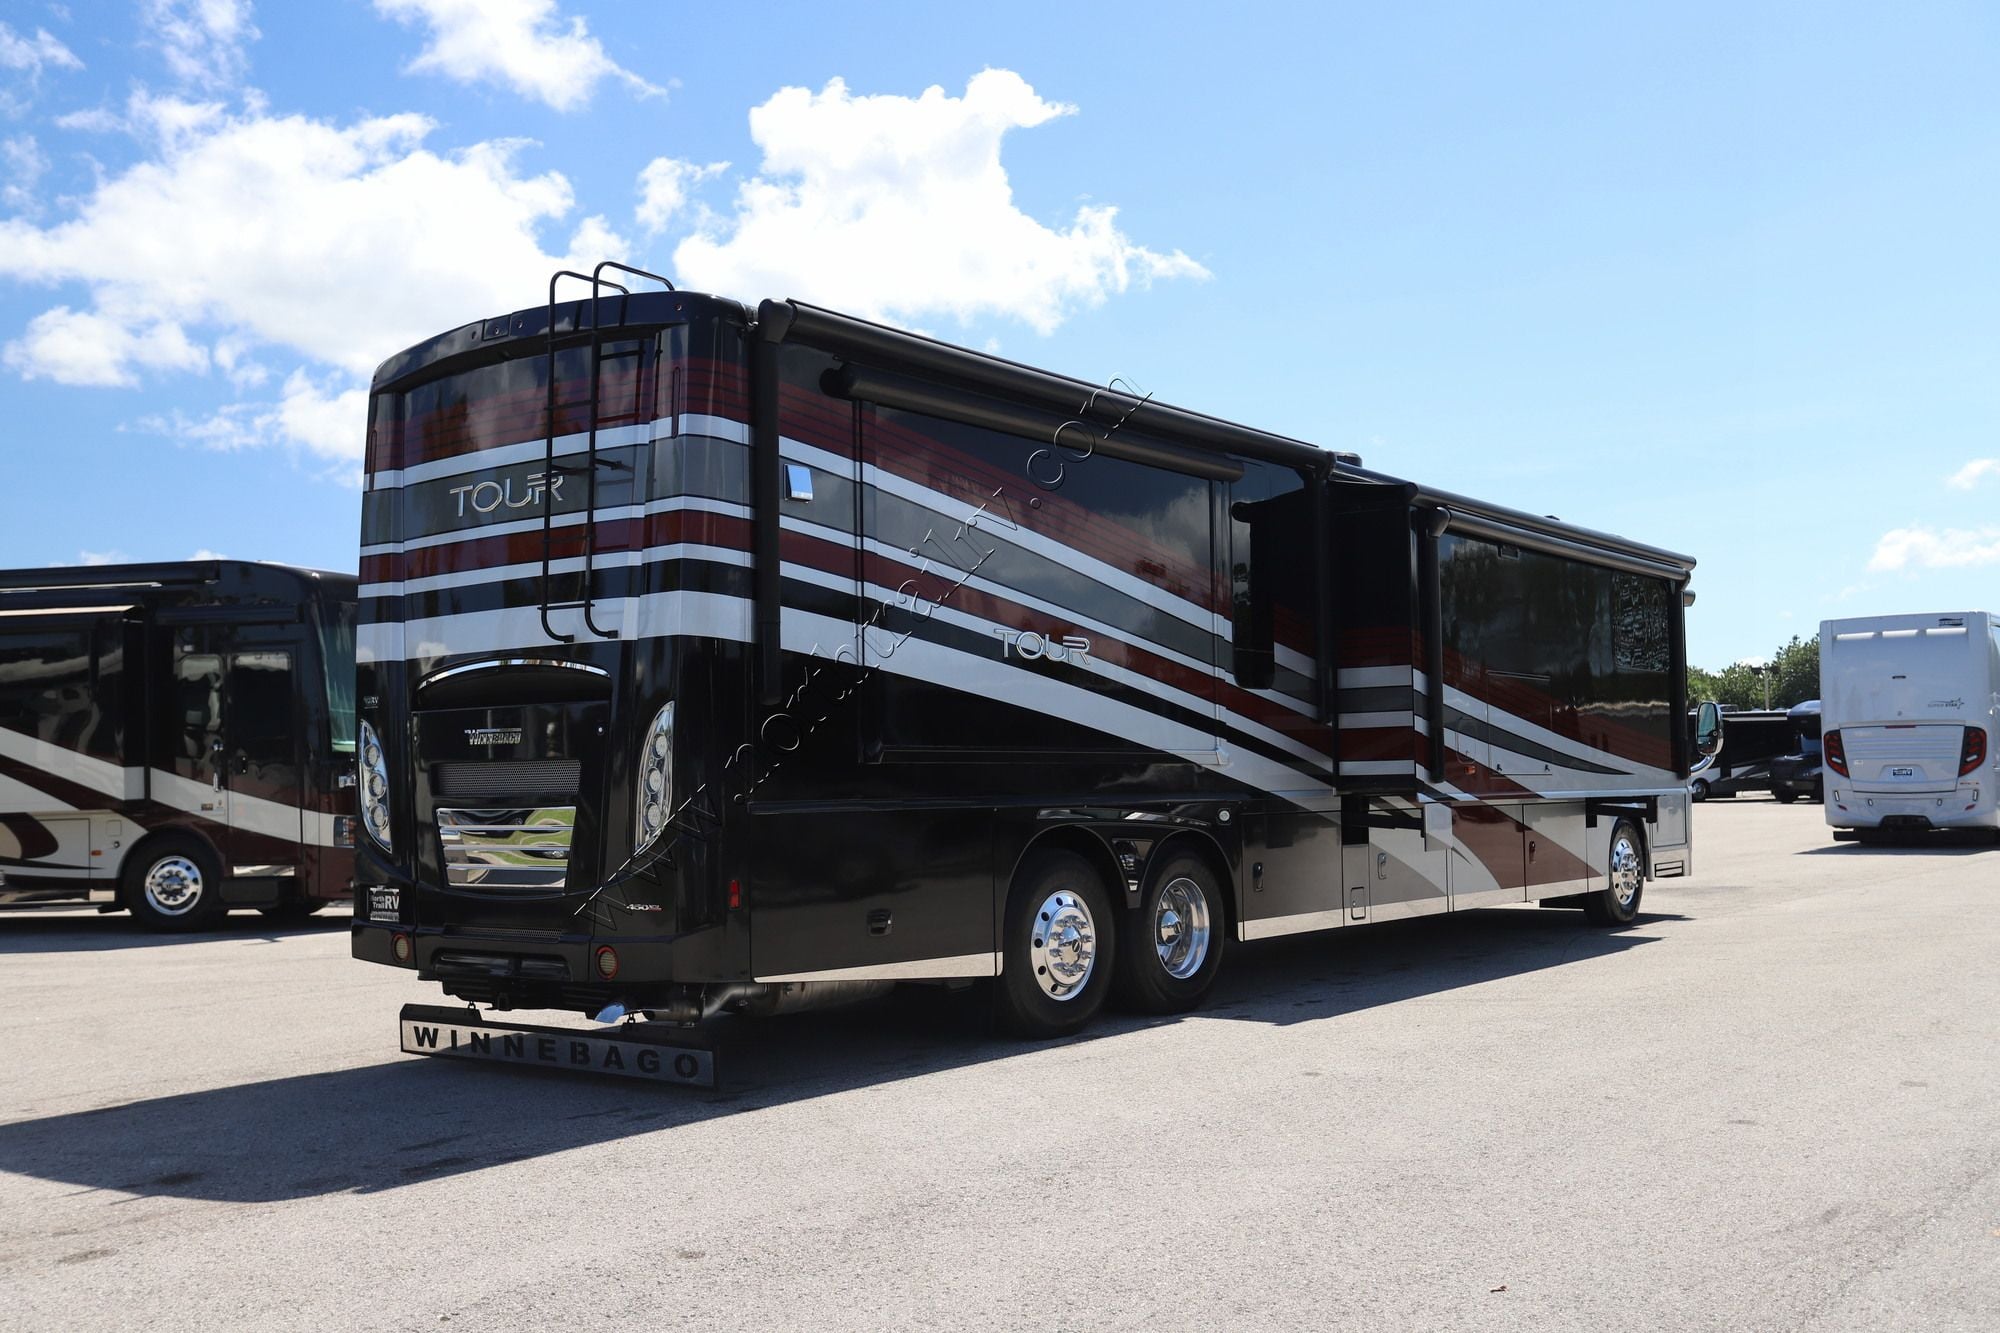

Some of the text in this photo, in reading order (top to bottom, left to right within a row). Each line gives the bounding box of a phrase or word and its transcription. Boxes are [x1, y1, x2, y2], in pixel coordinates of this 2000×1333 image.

[449, 470, 564, 517] TOUR
[993, 628, 1091, 665] TOUR
[385, 895, 400, 910] RV
[413, 1025, 699, 1079] WINNEBAGO
